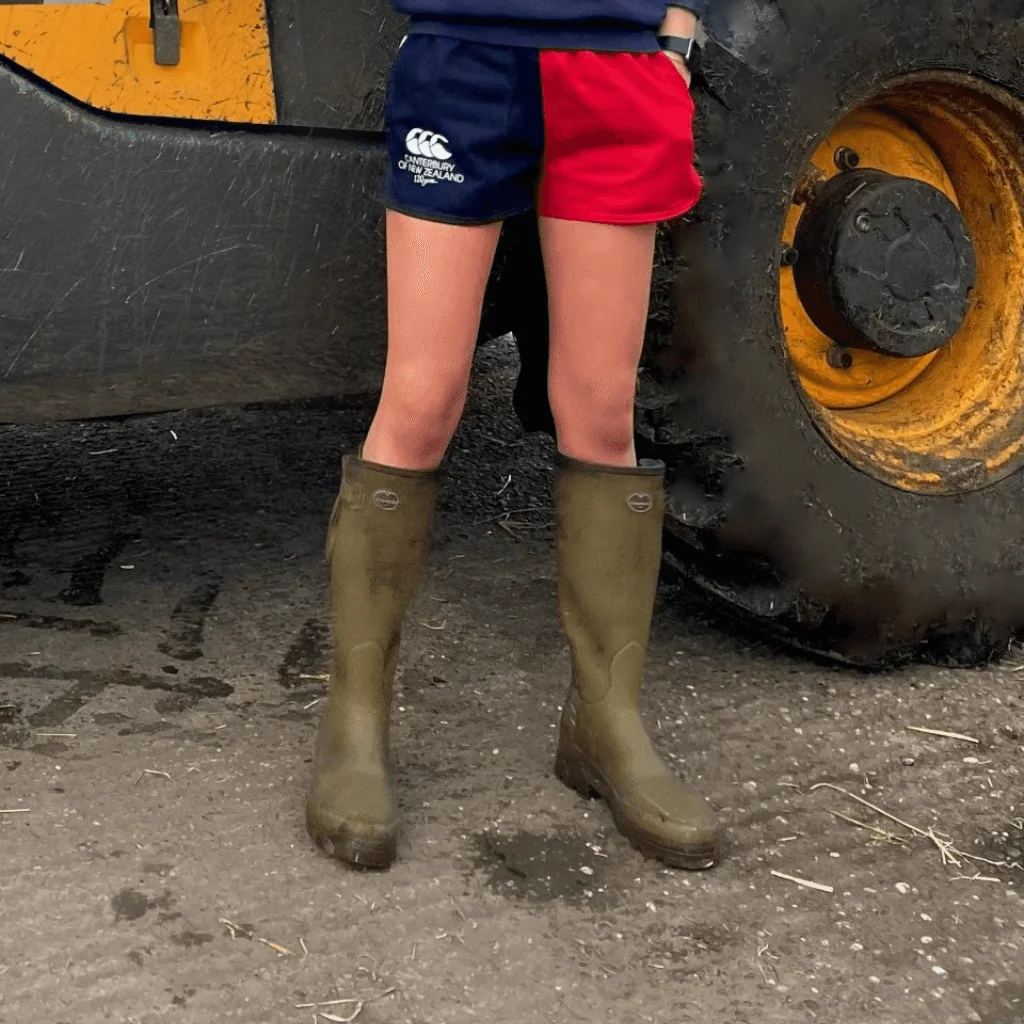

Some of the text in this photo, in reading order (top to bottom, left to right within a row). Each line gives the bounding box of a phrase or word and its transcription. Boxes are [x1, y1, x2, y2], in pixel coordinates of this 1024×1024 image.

[398, 160, 408, 170] OF
[408, 163, 423, 174] NEW
[423, 167, 465, 183] ZEALAND
[404, 154, 456, 172] CANTERBURY
